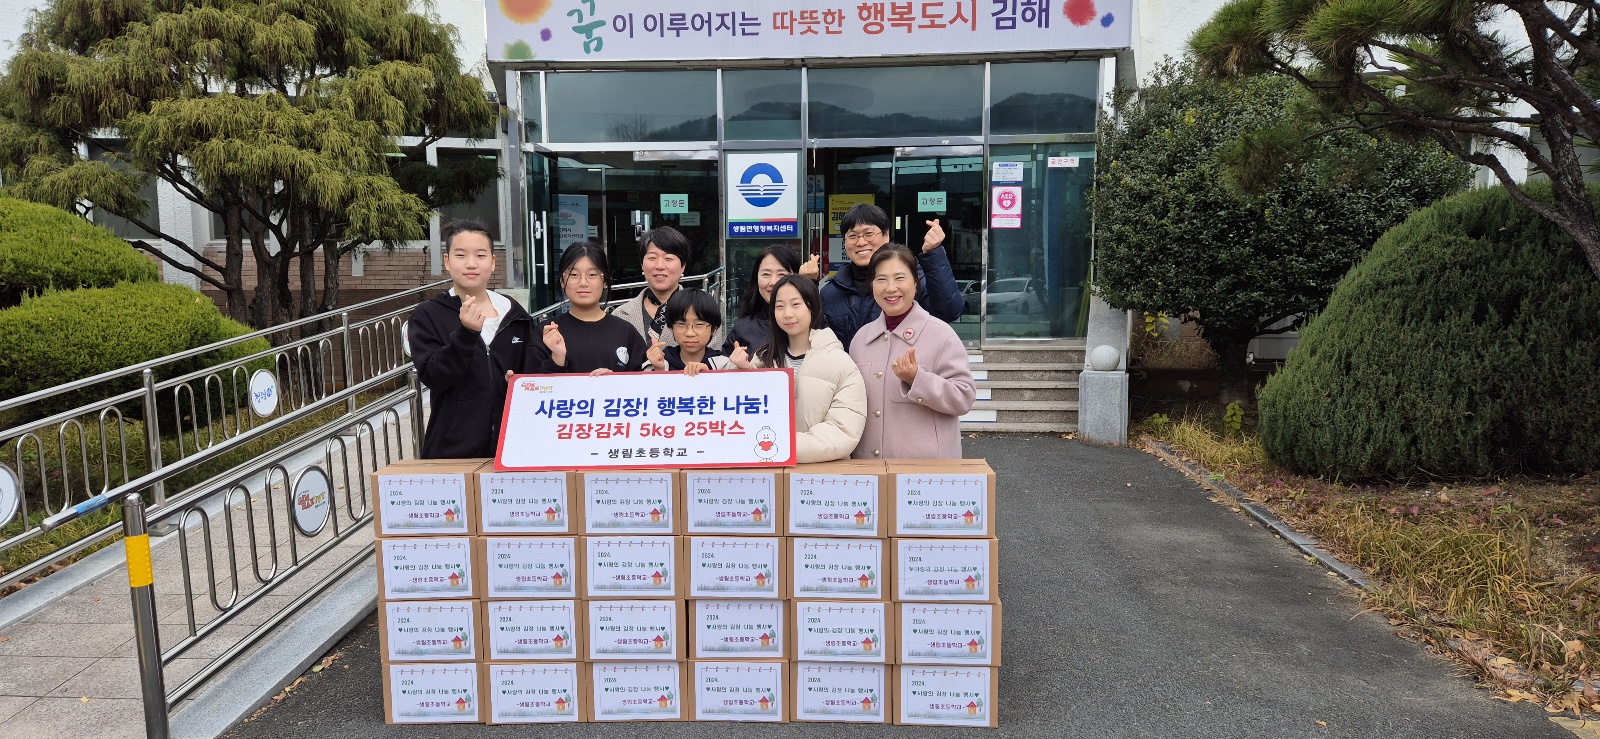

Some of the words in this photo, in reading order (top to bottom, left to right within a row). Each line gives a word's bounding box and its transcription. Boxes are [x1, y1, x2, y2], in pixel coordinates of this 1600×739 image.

[643, 11, 762, 37] 이루어지는
[772, 8, 846, 36] 따뜻한
[856, 0, 976, 35] 행복도시
[990, 0, 1050, 30] 김해
[664, 199, 685, 208] 고정문
[920, 197, 944, 206] 고정문
[732, 224, 794, 233] 생림면행정복지센터
[535, 398, 594, 418] 사랑의
[602, 398, 648, 418] 김장!
[657, 396, 716, 416] 행복한
[724, 395, 769, 414] 나눔!
[556, 422, 630, 440] 김장김치
[640, 422, 676, 440] 5kg
[684, 420, 746, 437] 25박스
[608, 447, 688, 458] 생림초등학교
